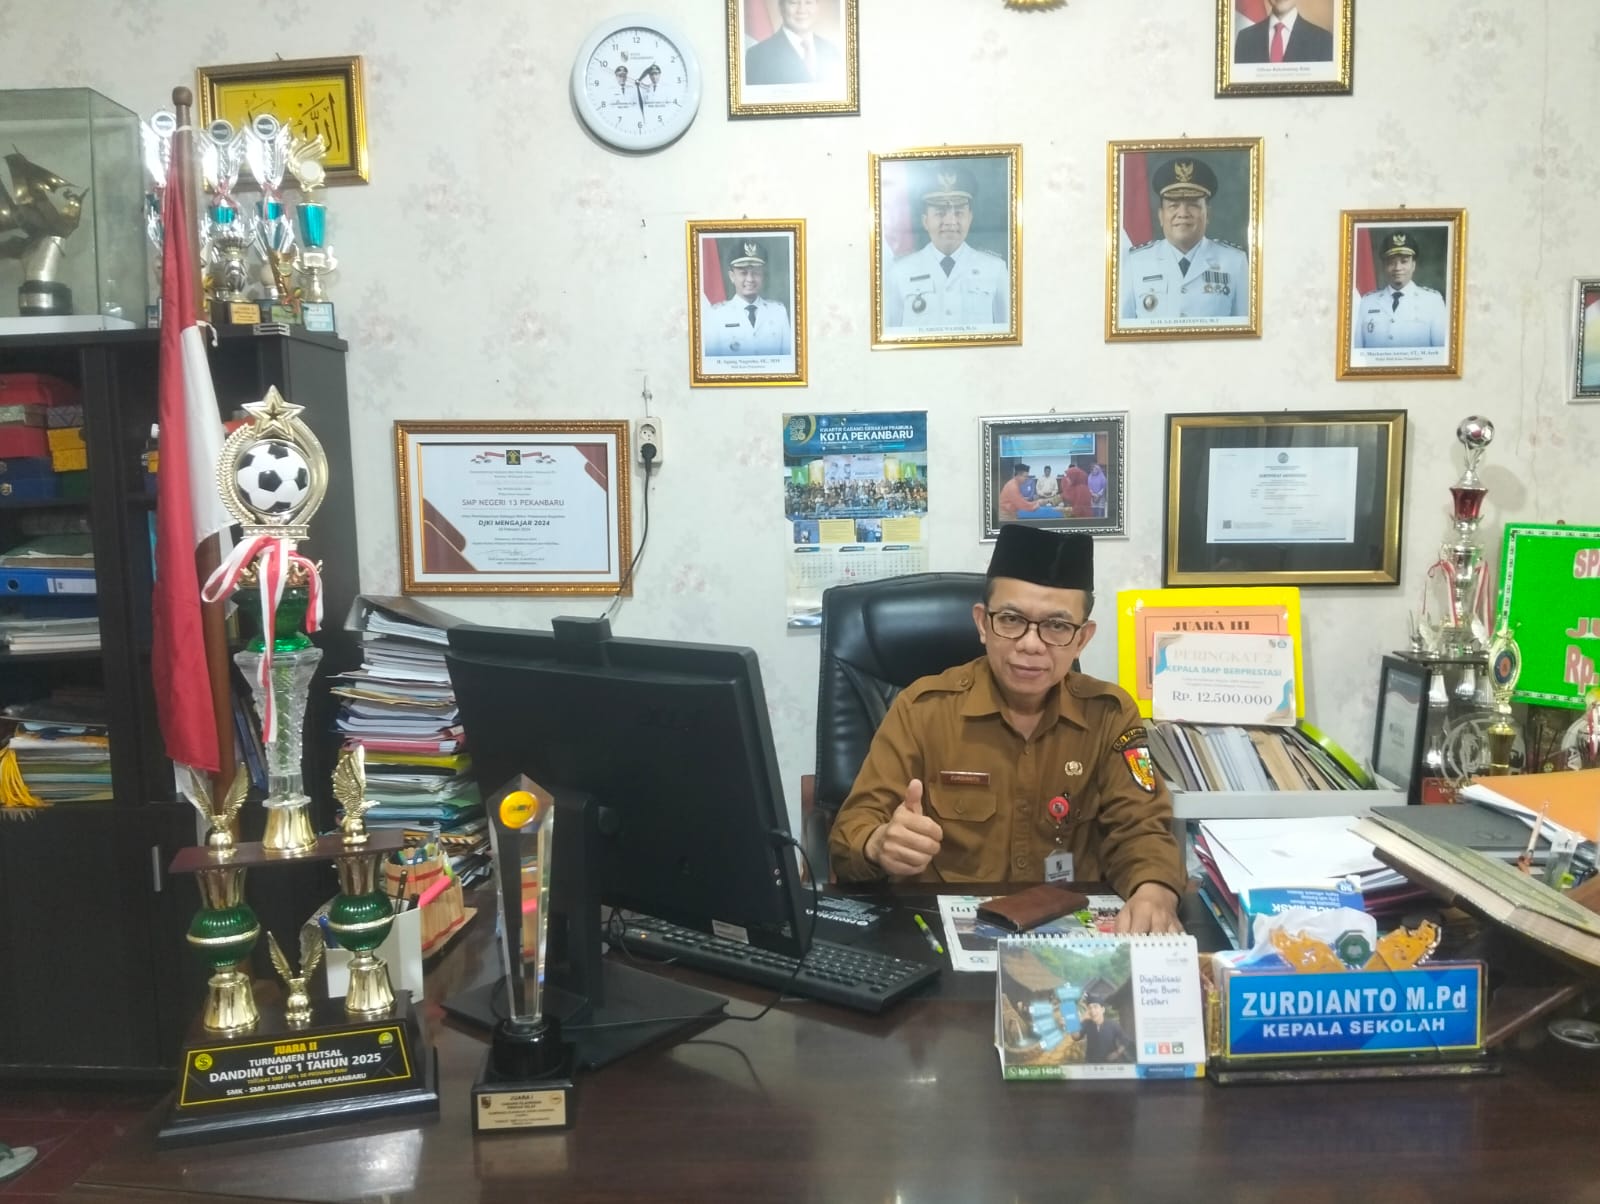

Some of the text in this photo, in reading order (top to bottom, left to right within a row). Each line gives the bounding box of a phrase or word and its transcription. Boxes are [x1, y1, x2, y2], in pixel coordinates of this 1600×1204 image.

[820, 430, 914, 441] KOTA PEKANBARU
[1172, 621, 1250, 631] JUARA III
[1174, 648, 1273, 664] PERINGKAT 2
[1166, 664, 1282, 677] KEPALA SMP BERPRESTASI
[1172, 690, 1273, 705] Rp. 12.500.000
[1140, 975, 1181, 985] Digitalisasi
[1161, 985, 1180, 994] Bumi
[1241, 985, 1467, 1017] ZURDIANTO M.Pd
[1263, 1017, 1445, 1038] KEPALA SEKOLAH
[274, 1043, 307, 1056] JUARA
[248, 1049, 343, 1067] TURNAMEN FUTSAL
[209, 1052, 382, 1083] DANDIM CUP 1 TAHUN 2025
[226, 1087, 244, 1097] SMK
[249, 1085, 266, 1093] SMP
[267, 1081, 297, 1091] TARUNA
[298, 1078, 323, 1087] SATRIA
[324, 1073, 368, 1084] PEKANBARU
